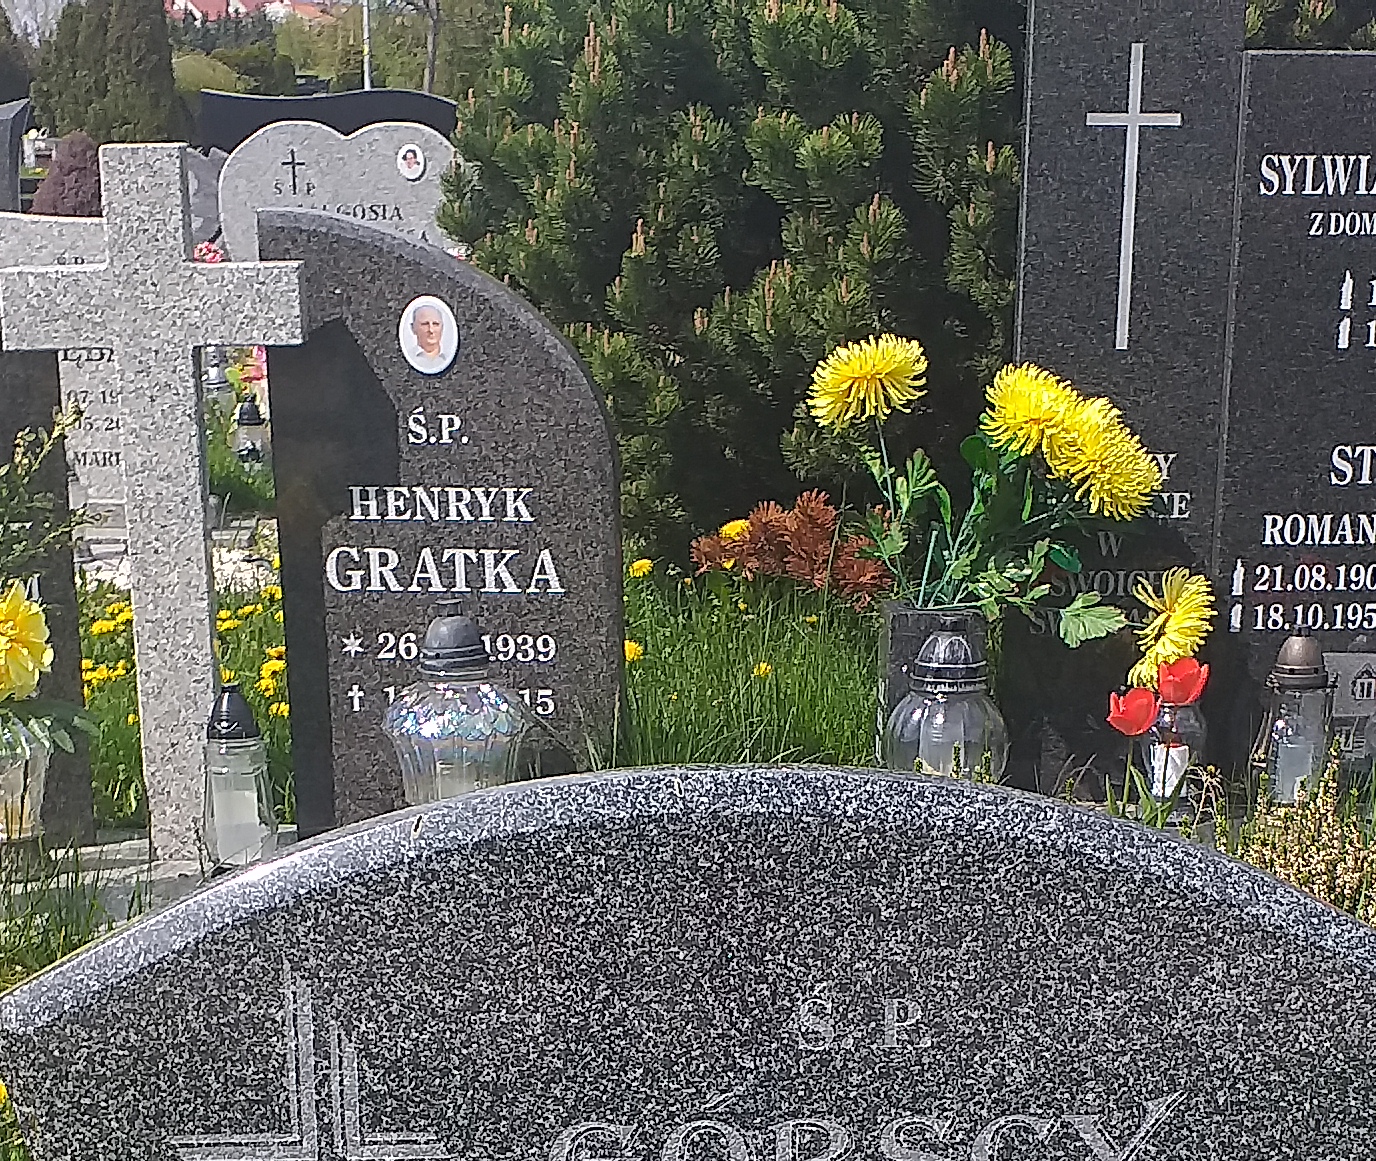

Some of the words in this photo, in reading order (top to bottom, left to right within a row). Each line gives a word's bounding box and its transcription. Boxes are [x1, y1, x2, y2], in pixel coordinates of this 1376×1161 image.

[1308, 212, 1324, 236] Z
[407, 406, 469, 444] Ś.P.
[348, 485, 535, 522] HENRYK
[325, 547, 566, 593] GRATKA
